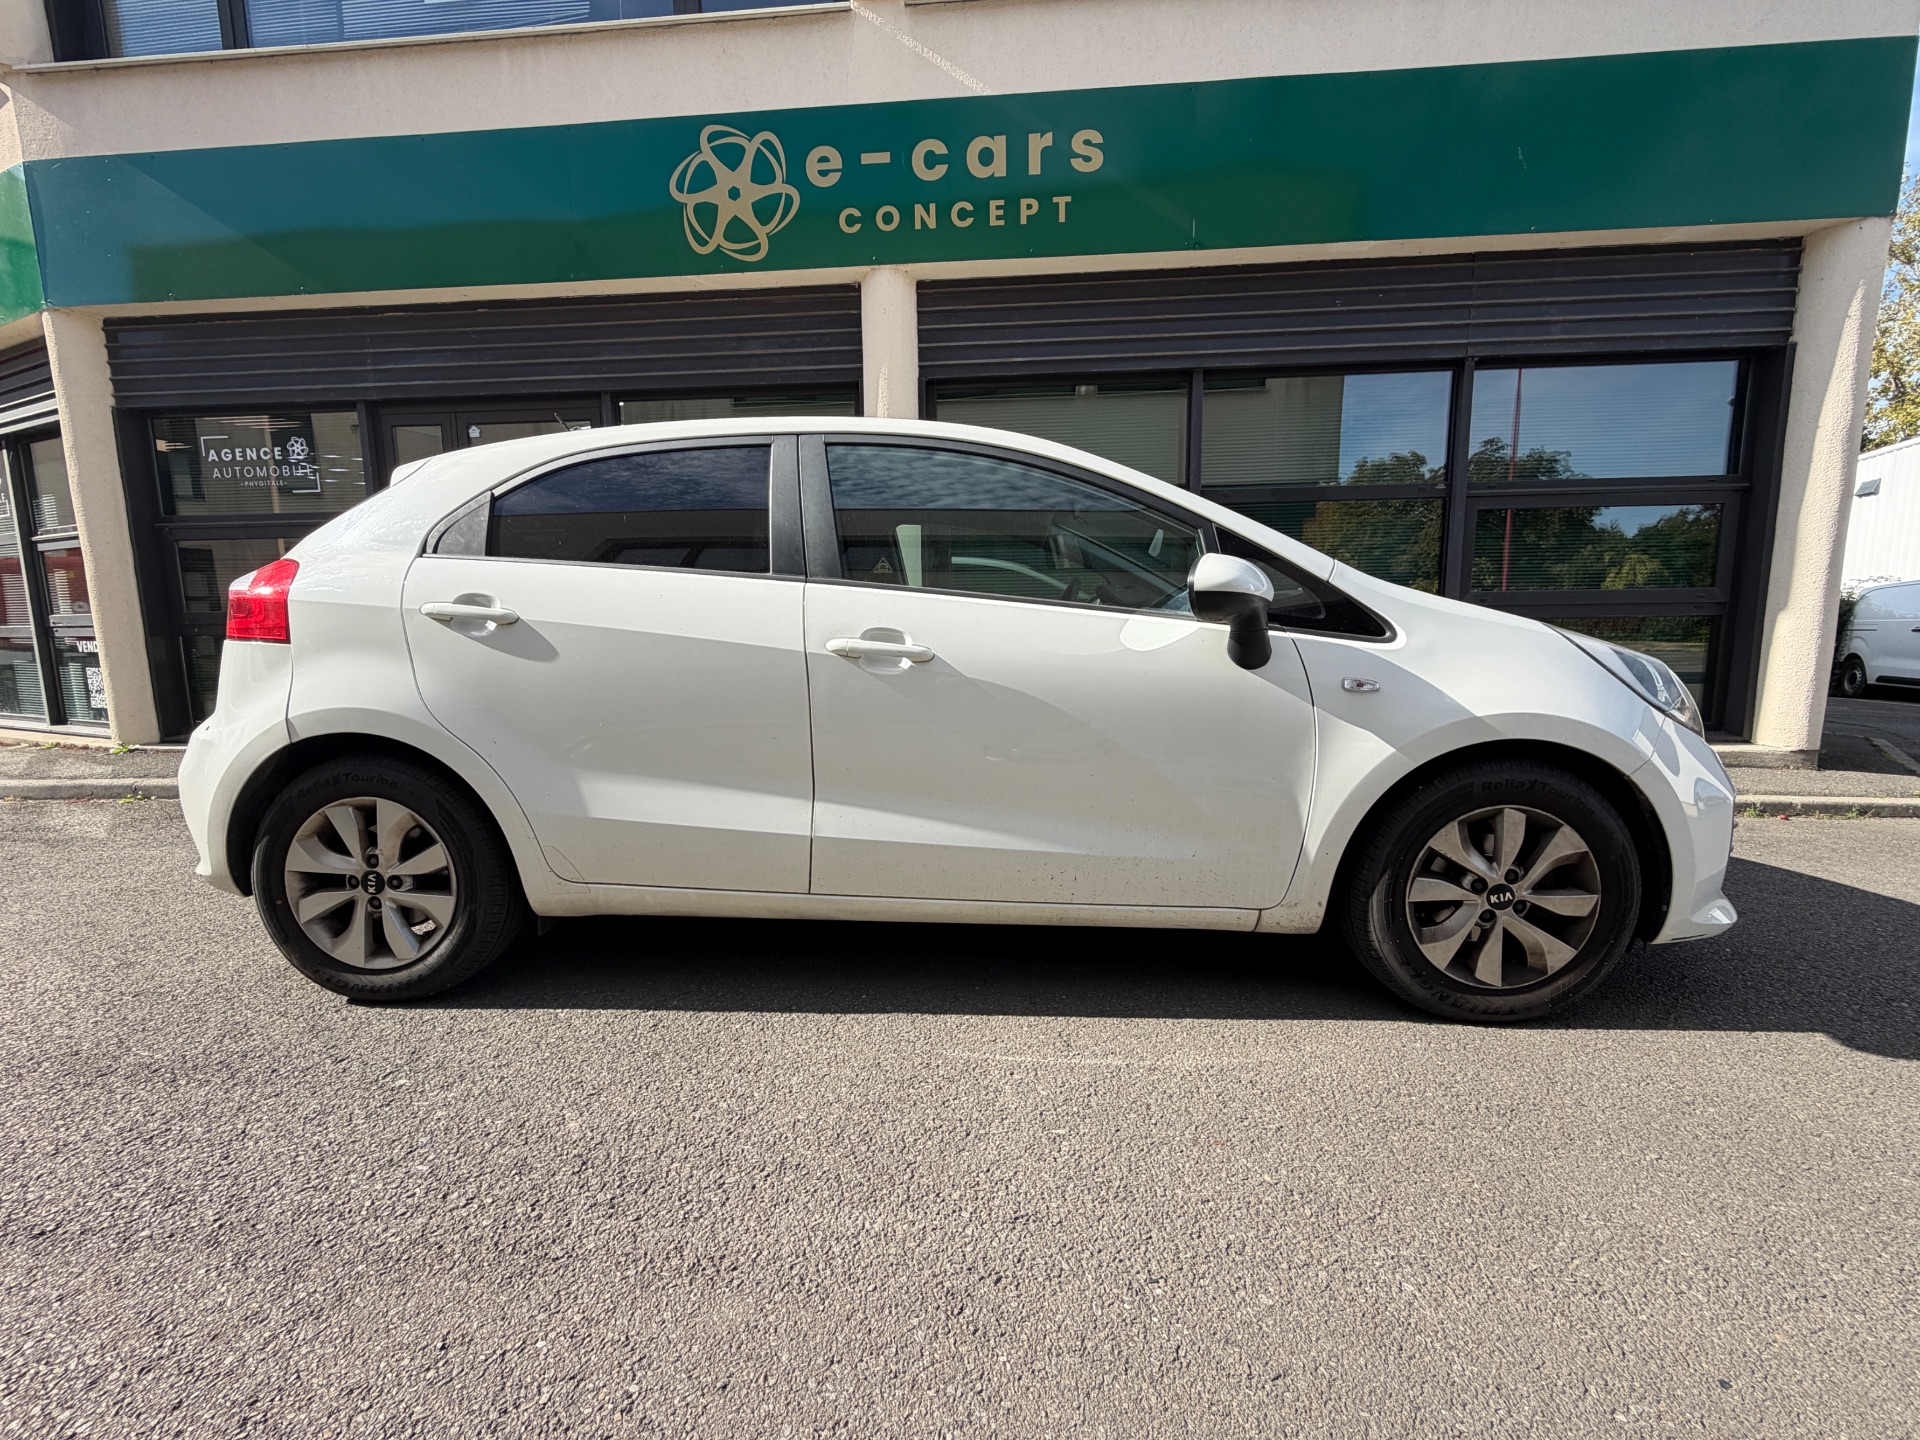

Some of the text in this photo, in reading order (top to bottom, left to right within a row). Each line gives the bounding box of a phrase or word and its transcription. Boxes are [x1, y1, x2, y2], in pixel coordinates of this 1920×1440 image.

[839, 196, 1072, 234] CONCEPT
[208, 447, 282, 462] AGENCE
[212, 464, 314, 479] AUTOMOBILE
[367, 873, 377, 893] KIA
[1489, 891, 1513, 904] KIA
